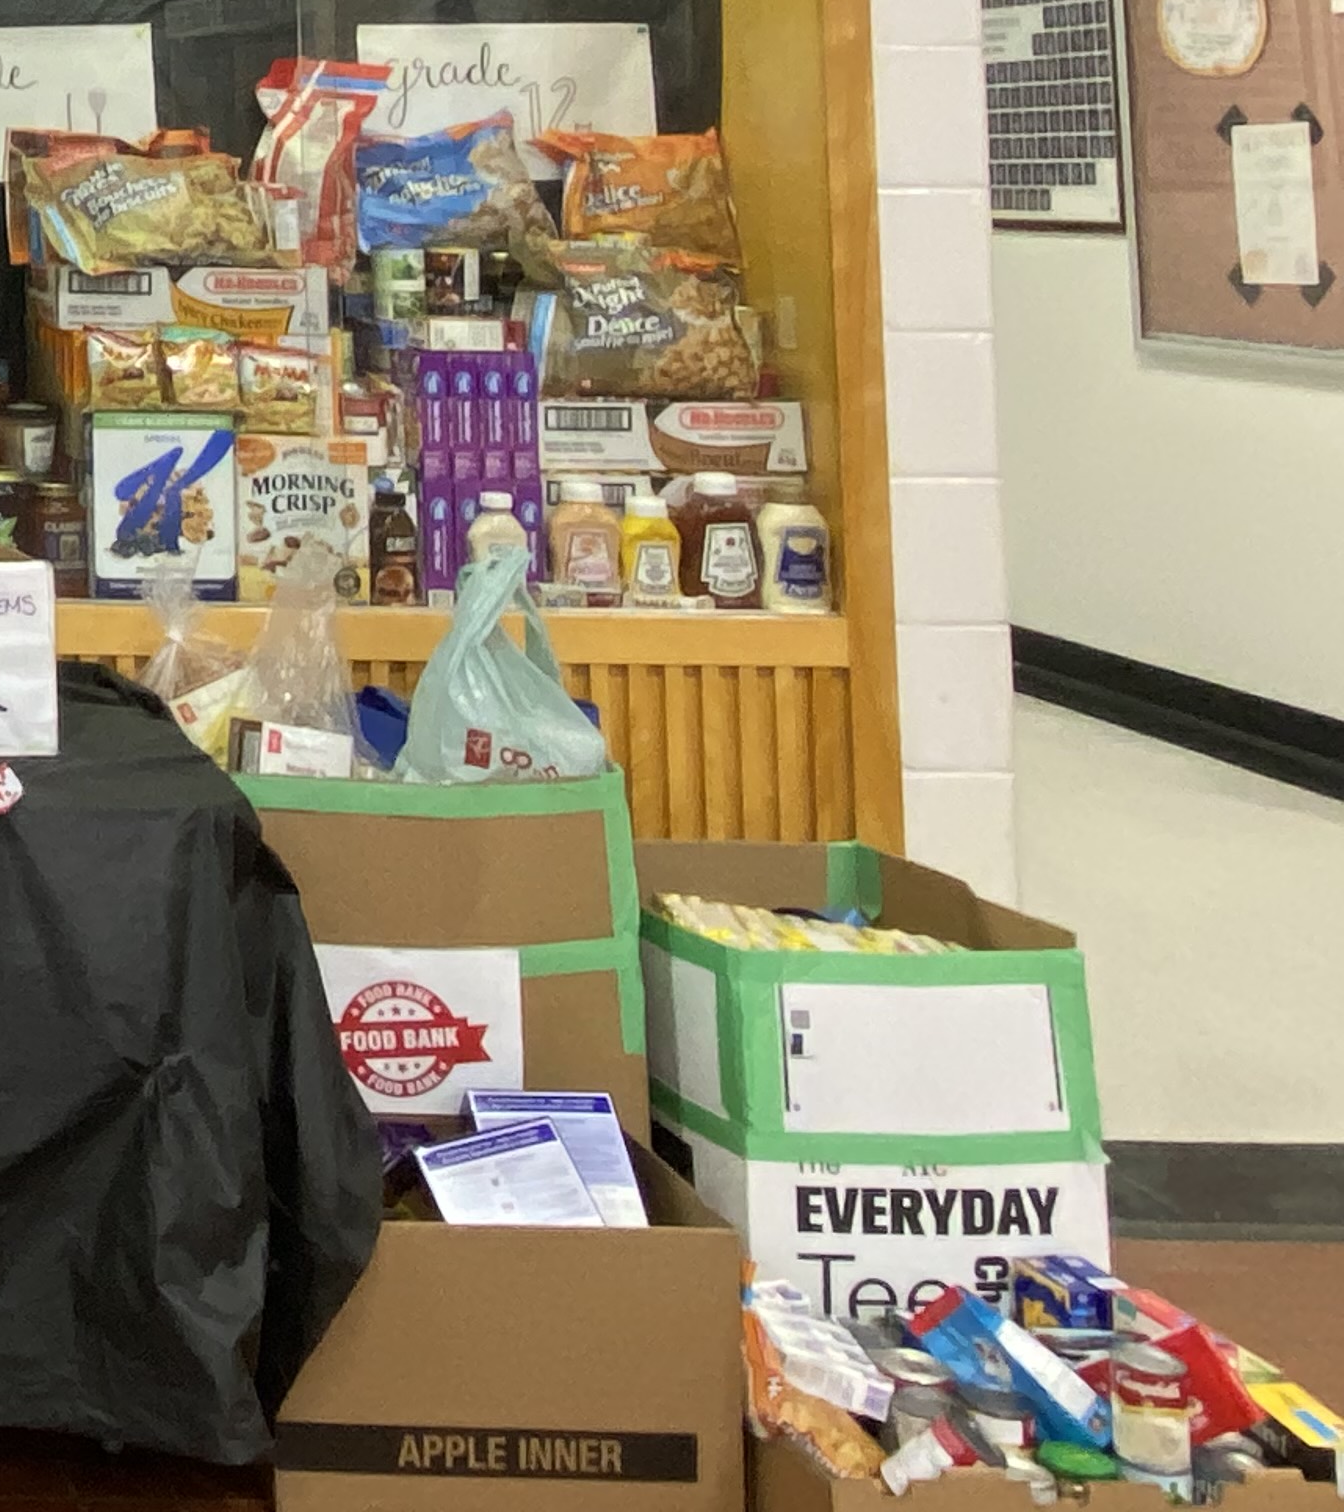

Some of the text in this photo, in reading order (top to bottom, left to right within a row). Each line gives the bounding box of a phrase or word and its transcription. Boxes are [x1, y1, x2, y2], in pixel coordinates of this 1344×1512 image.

[386, 42, 516, 128] grade
[251, 473, 356, 500] MORNING
[270, 496, 336, 515] CRISP
[356, 982, 435, 1009] FOOD BANK
[340, 1026, 460, 1053] FOOD BANK
[367, 1070, 442, 1095] FOOD BANK
[795, 1186, 1059, 1236] EVERYDAY
[397, 1433, 623, 1475] APPLE INNER
